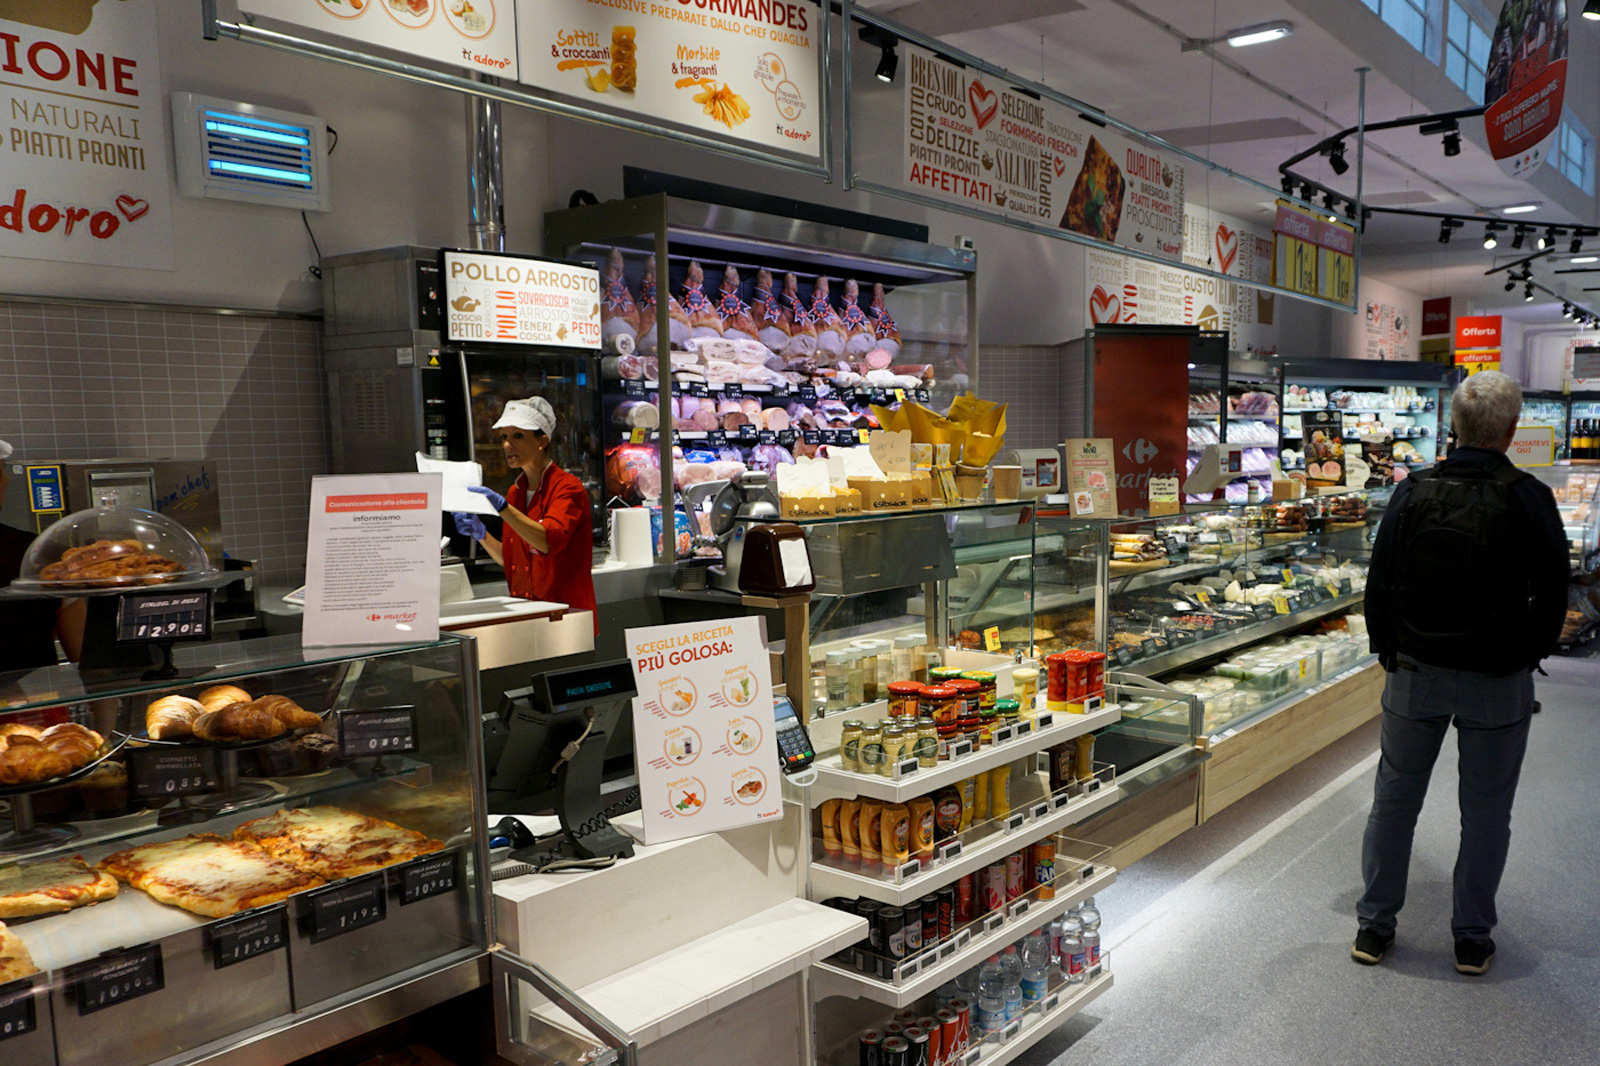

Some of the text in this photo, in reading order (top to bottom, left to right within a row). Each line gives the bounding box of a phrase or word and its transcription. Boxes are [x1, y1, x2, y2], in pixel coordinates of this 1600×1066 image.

[587, 0, 810, 48] CLUSIVE PREPARATE DALLO CHEF QUAGLIA
[664, 0, 808, 32] URMANDES
[556, 29, 600, 48] Sottili
[0, 32, 139, 97] IONE
[462, 48, 505, 69] ti adoro
[551, 44, 610, 60] & croccanti
[676, 44, 720, 61] Morbide
[672, 62, 718, 79] & fragranti
[911, 53, 966, 103] BRESAOLA
[910, 86, 924, 140] COTTO
[926, 93, 966, 119] CRUDO
[11, 98, 141, 140] NATURALI
[940, 116, 974, 136] SELEZIONE
[1001, 92, 1083, 146] SELEZIONE TRADIZIONE
[1504, 117, 1522, 140] SONO
[10, 128, 146, 171] PIATTI PRONTI
[926, 126, 980, 160] DELIZIE
[985, 130, 1038, 158] STAGIONATURA
[1000, 119, 1078, 158] FORMAGGI FRESCHI
[910, 143, 980, 178] PIATTI PRONTI
[995, 148, 1038, 192] SALUME
[1126, 148, 1162, 185] QUALITÀ
[910, 162, 992, 204] AFFETTATI
[1038, 150, 1052, 219] SAPORE
[1140, 182, 1170, 200] BRESAOLA
[1009, 200, 1038, 216] QUALITÀ
[1131, 192, 1173, 216] PIATTI PRONTI
[1126, 204, 1178, 236] PROSCIUTTO
[1284, 214, 1310, 237] offerta
[1324, 228, 1348, 250] offerta
[451, 262, 598, 294] POLLO ARROSTO
[1160, 270, 1183, 286] FRESCO
[1184, 276, 1215, 296] GUSTO
[484, 288, 492, 328] ARROSTO
[518, 291, 570, 309] SOVRACOSCIA
[1123, 284, 1138, 324] STO
[451, 314, 482, 322] COSCIA
[496, 290, 518, 339] POLLO
[519, 306, 570, 322] ARROSTO
[519, 320, 552, 332] TENERI
[1426, 312, 1446, 322] Offerta
[452, 322, 482, 338] PETTO
[519, 332, 552, 342] COSCIA
[572, 322, 600, 336] PETTO
[1462, 328, 1496, 336] Offerta
[1463, 354, 1492, 362] offerta
[636, 626, 734, 656] SCEGLI LA RICETTA
[638, 640, 733, 673] PIÙ GOLOSA:
